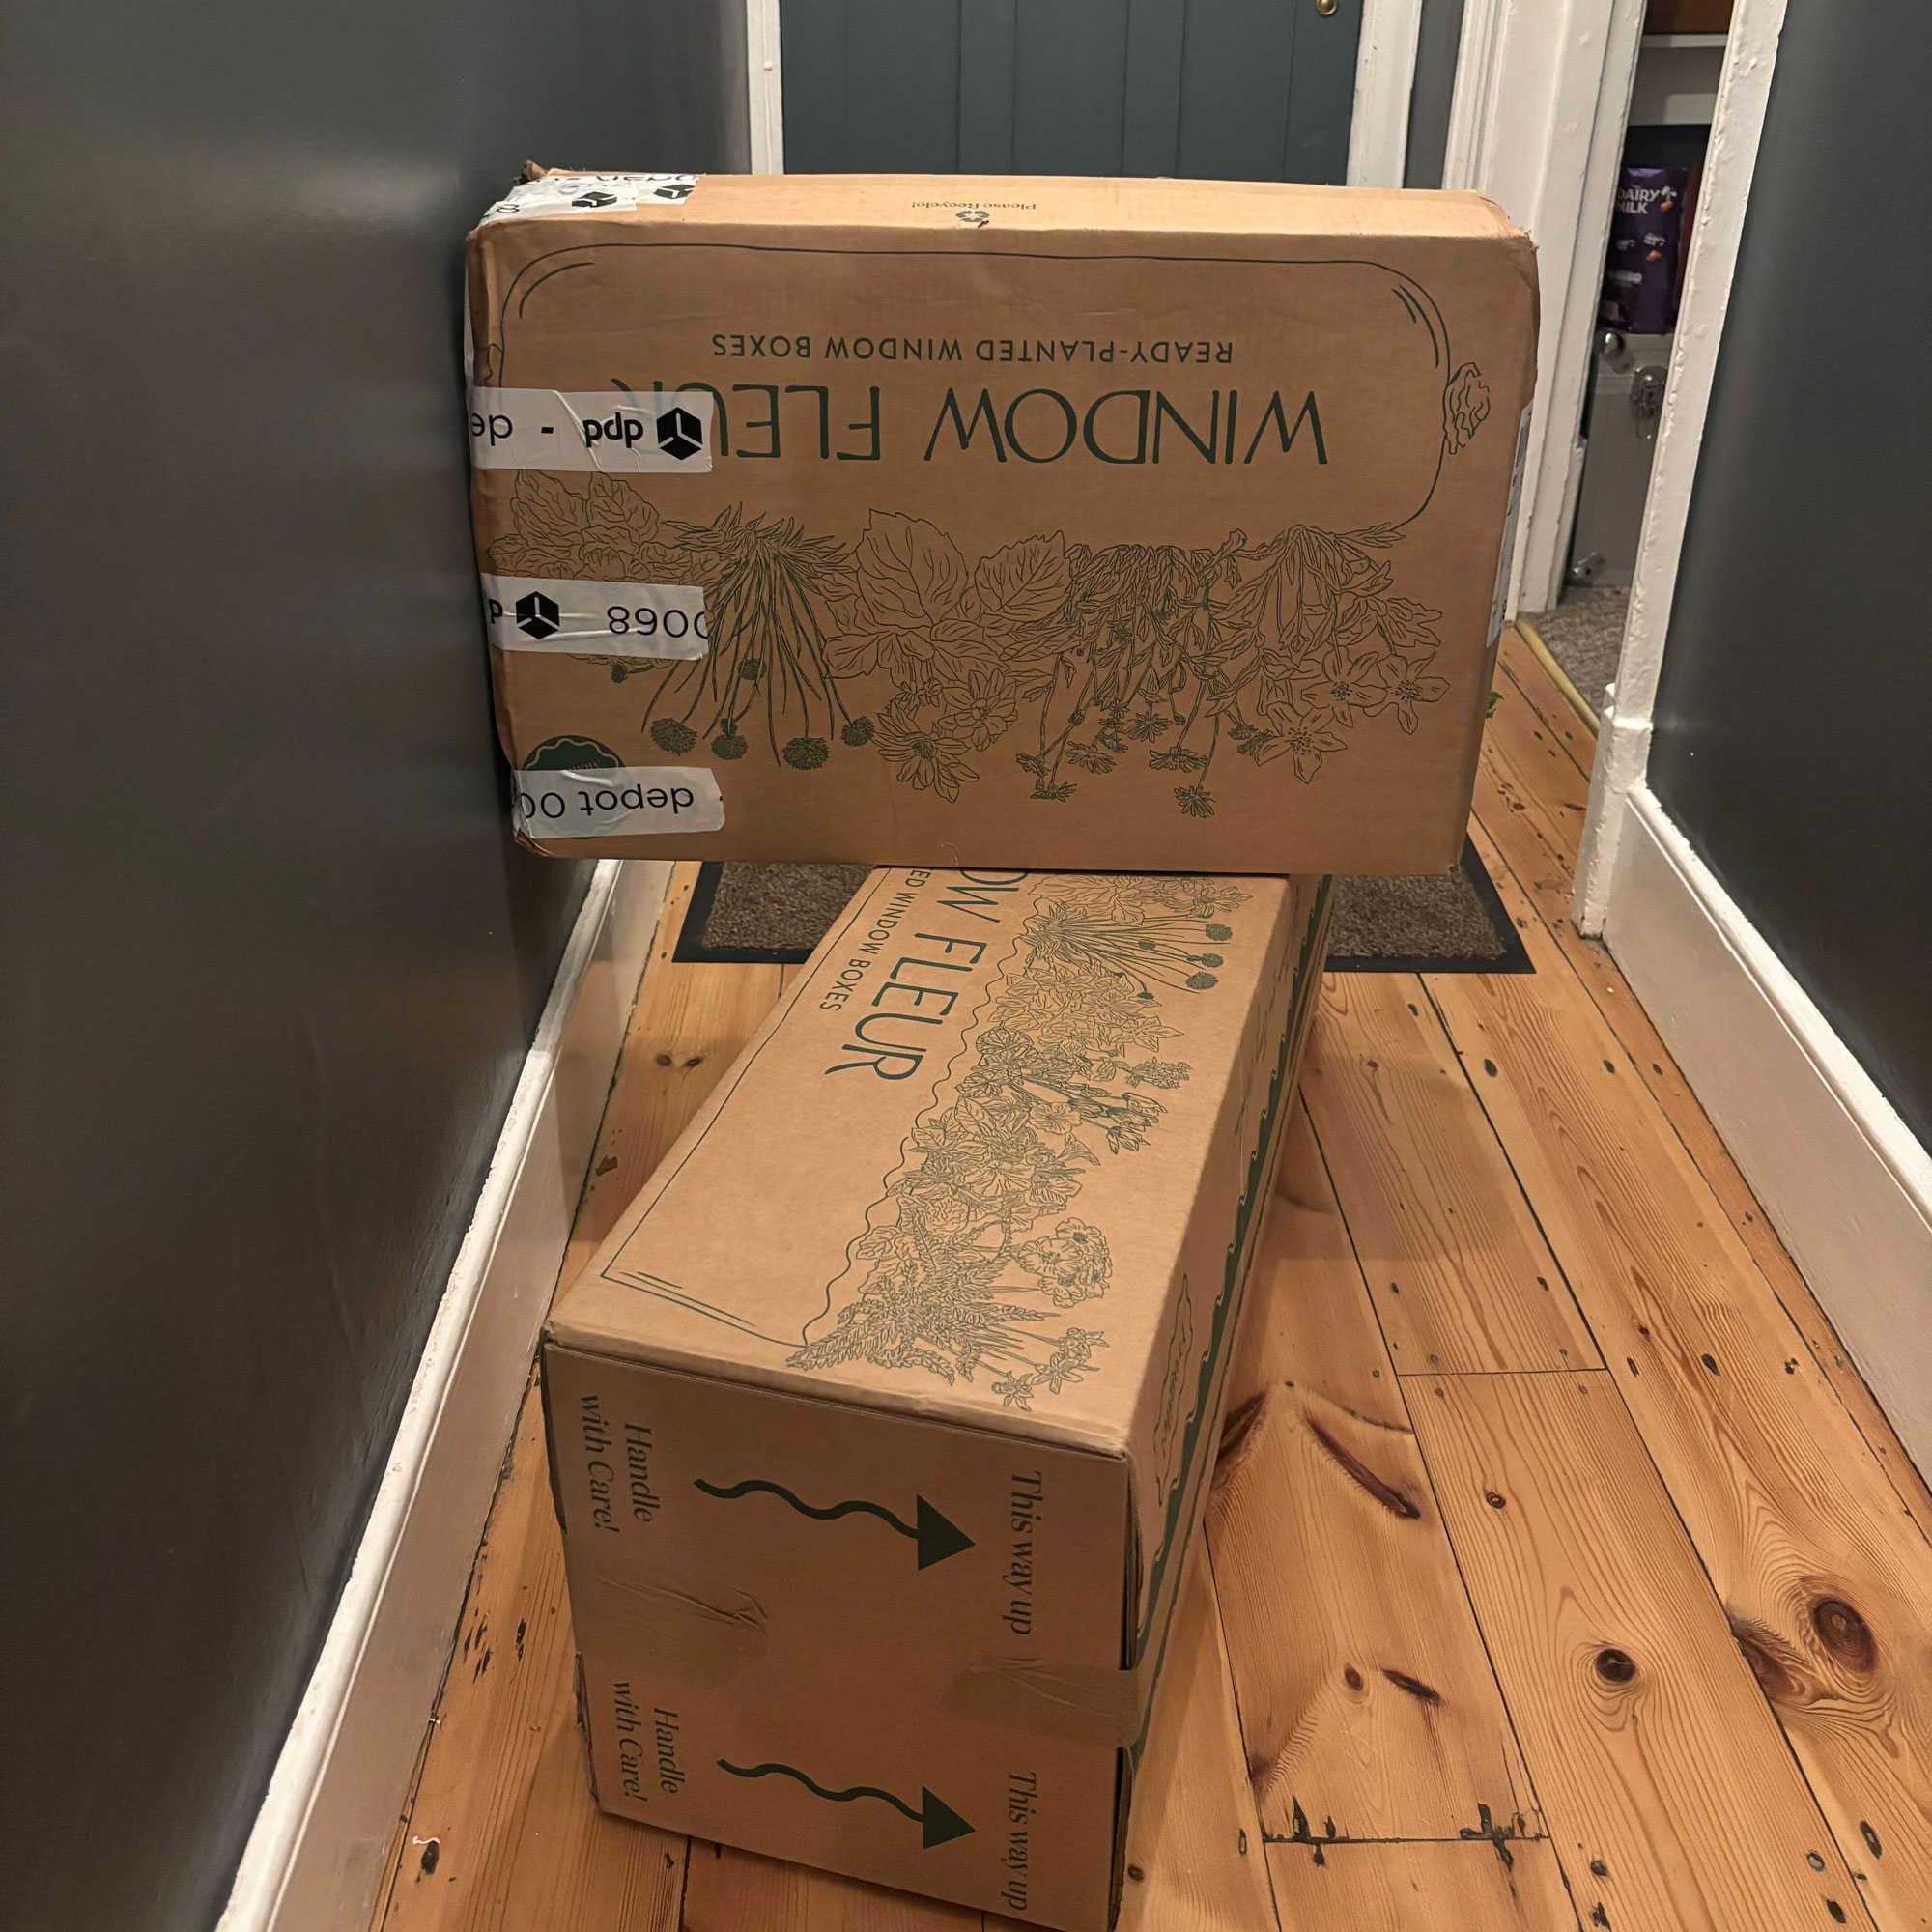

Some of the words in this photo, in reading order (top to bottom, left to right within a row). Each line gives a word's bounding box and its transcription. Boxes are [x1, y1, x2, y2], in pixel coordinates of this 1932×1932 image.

[1617, 188, 1661, 202] DAIRY
[712, 334, 810, 358] BOXES
[825, 336, 962, 361] WINDOW
[976, 339, 1233, 363] READY-PLANTED
[583, 412, 643, 448] dpd
[923, 387, 1328, 465] WINDOW
[579, 783, 694, 814] depot
[858, 892, 918, 955] WINDOW
[819, 958, 872, 1011] BOXES
[824, 932, 987, 1080] FLEUR
[581, 1395, 612, 1453] with
[587, 1460, 620, 1533] Care!
[624, 1422, 661, 1522] Handle
[1011, 1470, 1043, 1534] This
[1002, 1542, 1034, 1596] way
[1002, 1600, 1033, 1635] up
[613, 1682, 642, 1732] with
[619, 1738, 648, 1802] Care!
[653, 1707, 686, 1794] Handle
[1008, 1772, 1037, 1825] This
[1000, 1832, 1029, 1877] way
[1000, 1880, 1028, 1911] up
